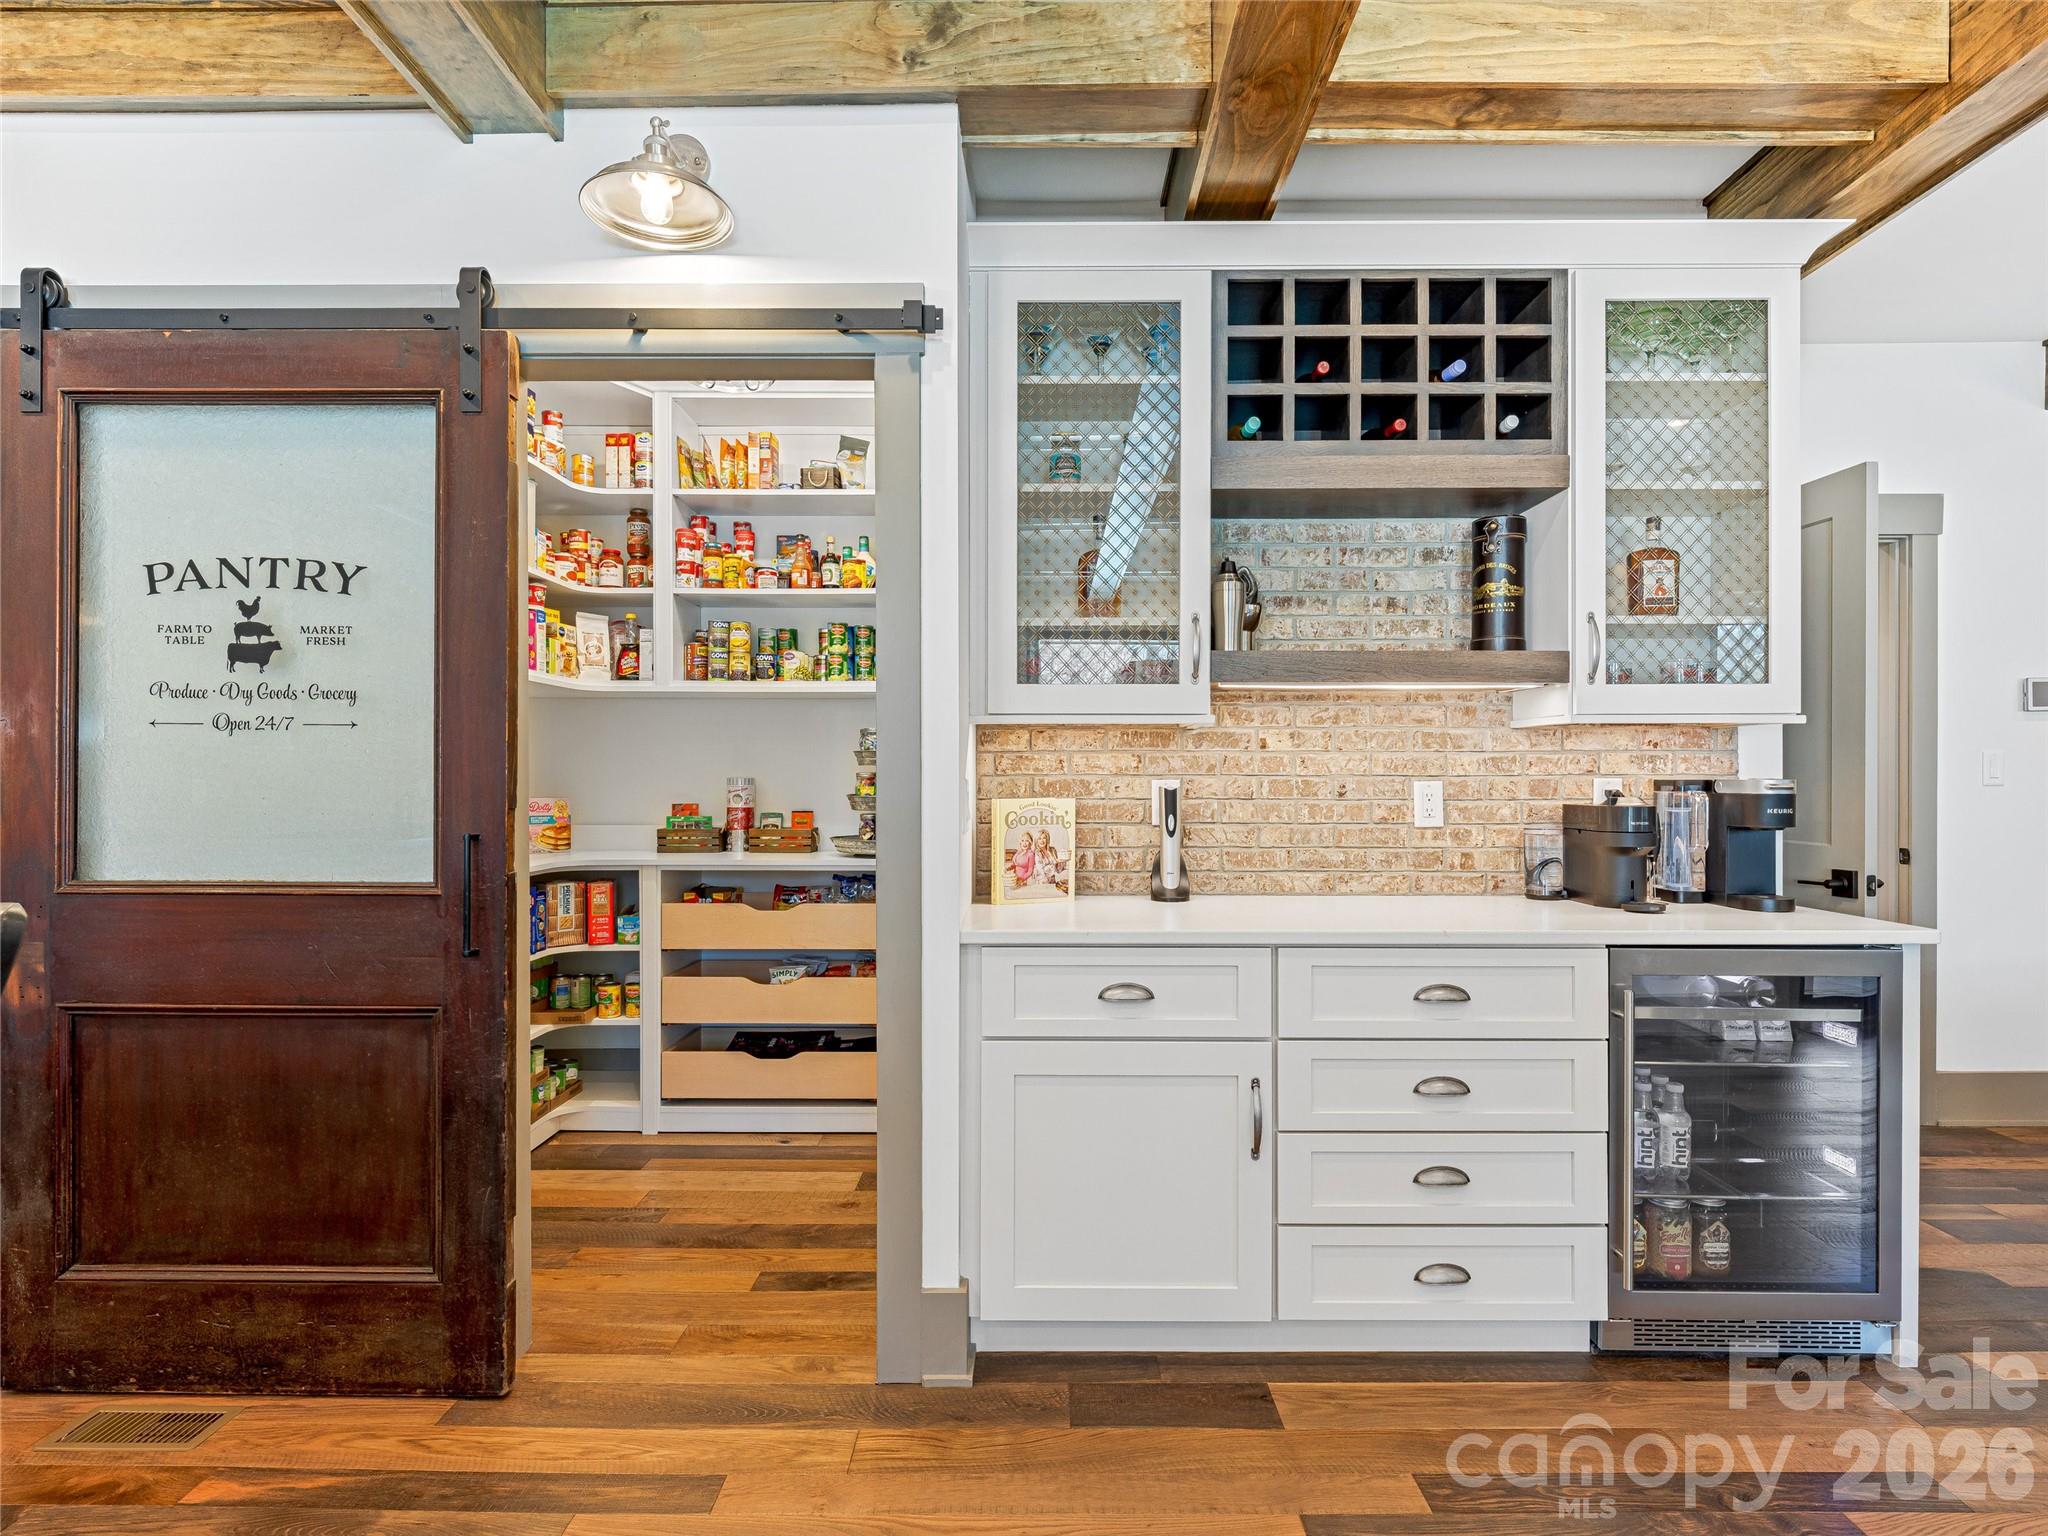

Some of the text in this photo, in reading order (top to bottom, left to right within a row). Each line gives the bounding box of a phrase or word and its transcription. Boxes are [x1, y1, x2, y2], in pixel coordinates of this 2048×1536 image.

[143, 557, 368, 596] PANTRY
[1473, 602, 1516, 610] ORDEAUX
[157, 624, 213, 634] FARM TO
[299, 625, 353, 635] MARKET
[164, 635, 206, 645] TABLE
[306, 636, 346, 646] FRESH
[149, 680, 358, 708] Produce Dry Goods Grocery
[211, 712, 295, 737] Open 24/7
[1004, 810, 1072, 829] Cookin'
[562, 885, 572, 915] PREMIUM
[771, 970, 799, 978] SIMPLY
[1637, 1130, 1653, 1167] hint
[1671, 1130, 1687, 1166] hint
